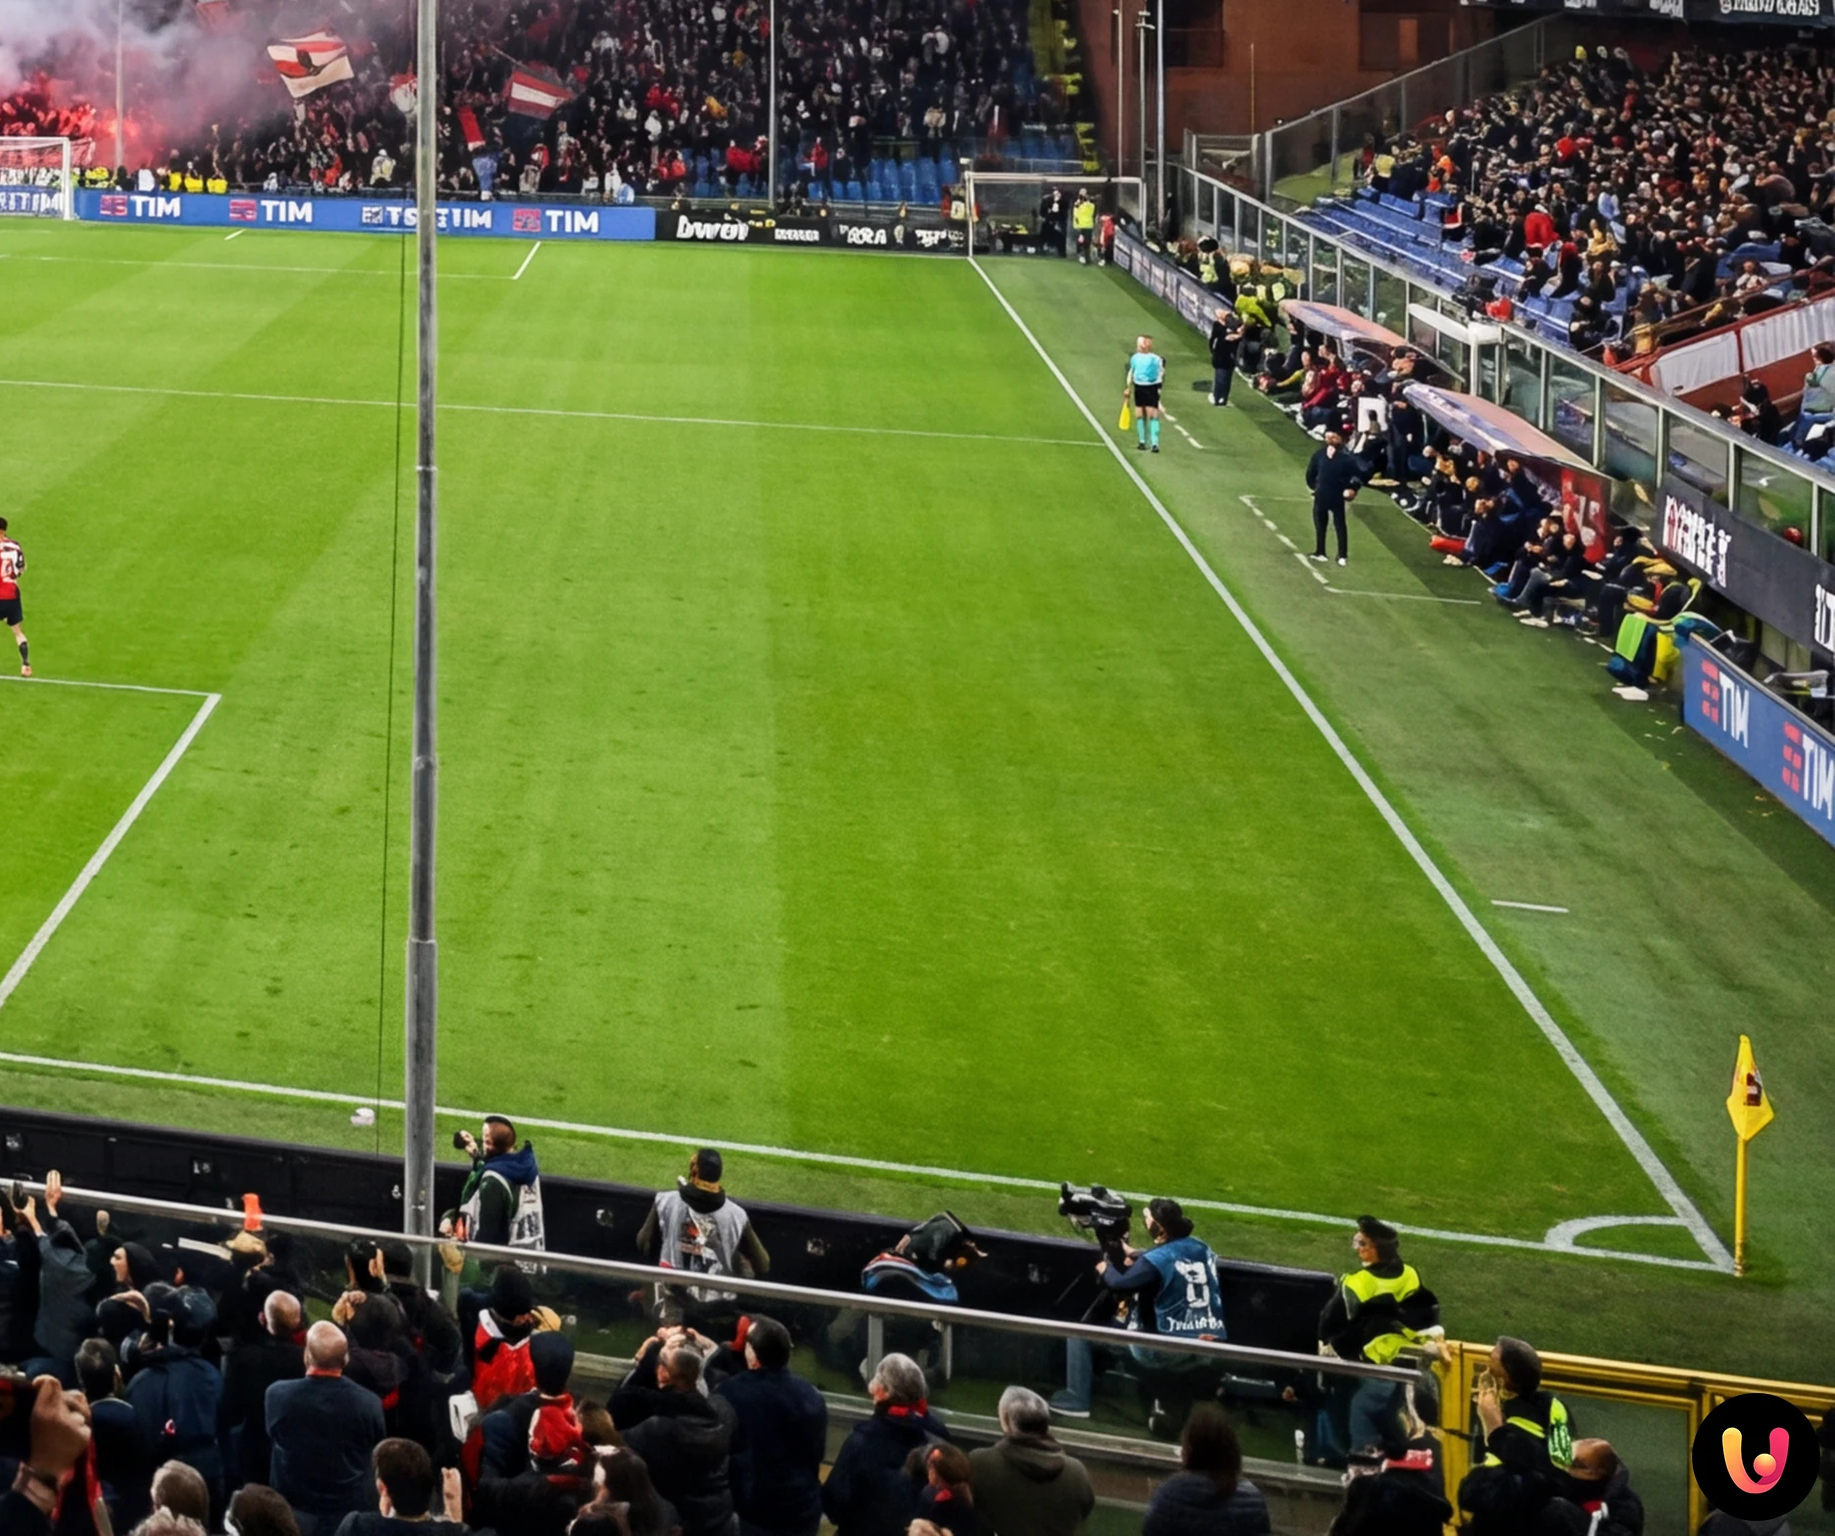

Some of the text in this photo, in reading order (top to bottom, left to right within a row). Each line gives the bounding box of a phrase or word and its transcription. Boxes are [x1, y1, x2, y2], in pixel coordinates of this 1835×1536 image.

[134, 195, 181, 217] TIM
[261, 200, 313, 223] TIM
[545, 210, 599, 233] TIM
[1718, 671, 1750, 749] TIM
[1802, 733, 1835, 821] TIM
